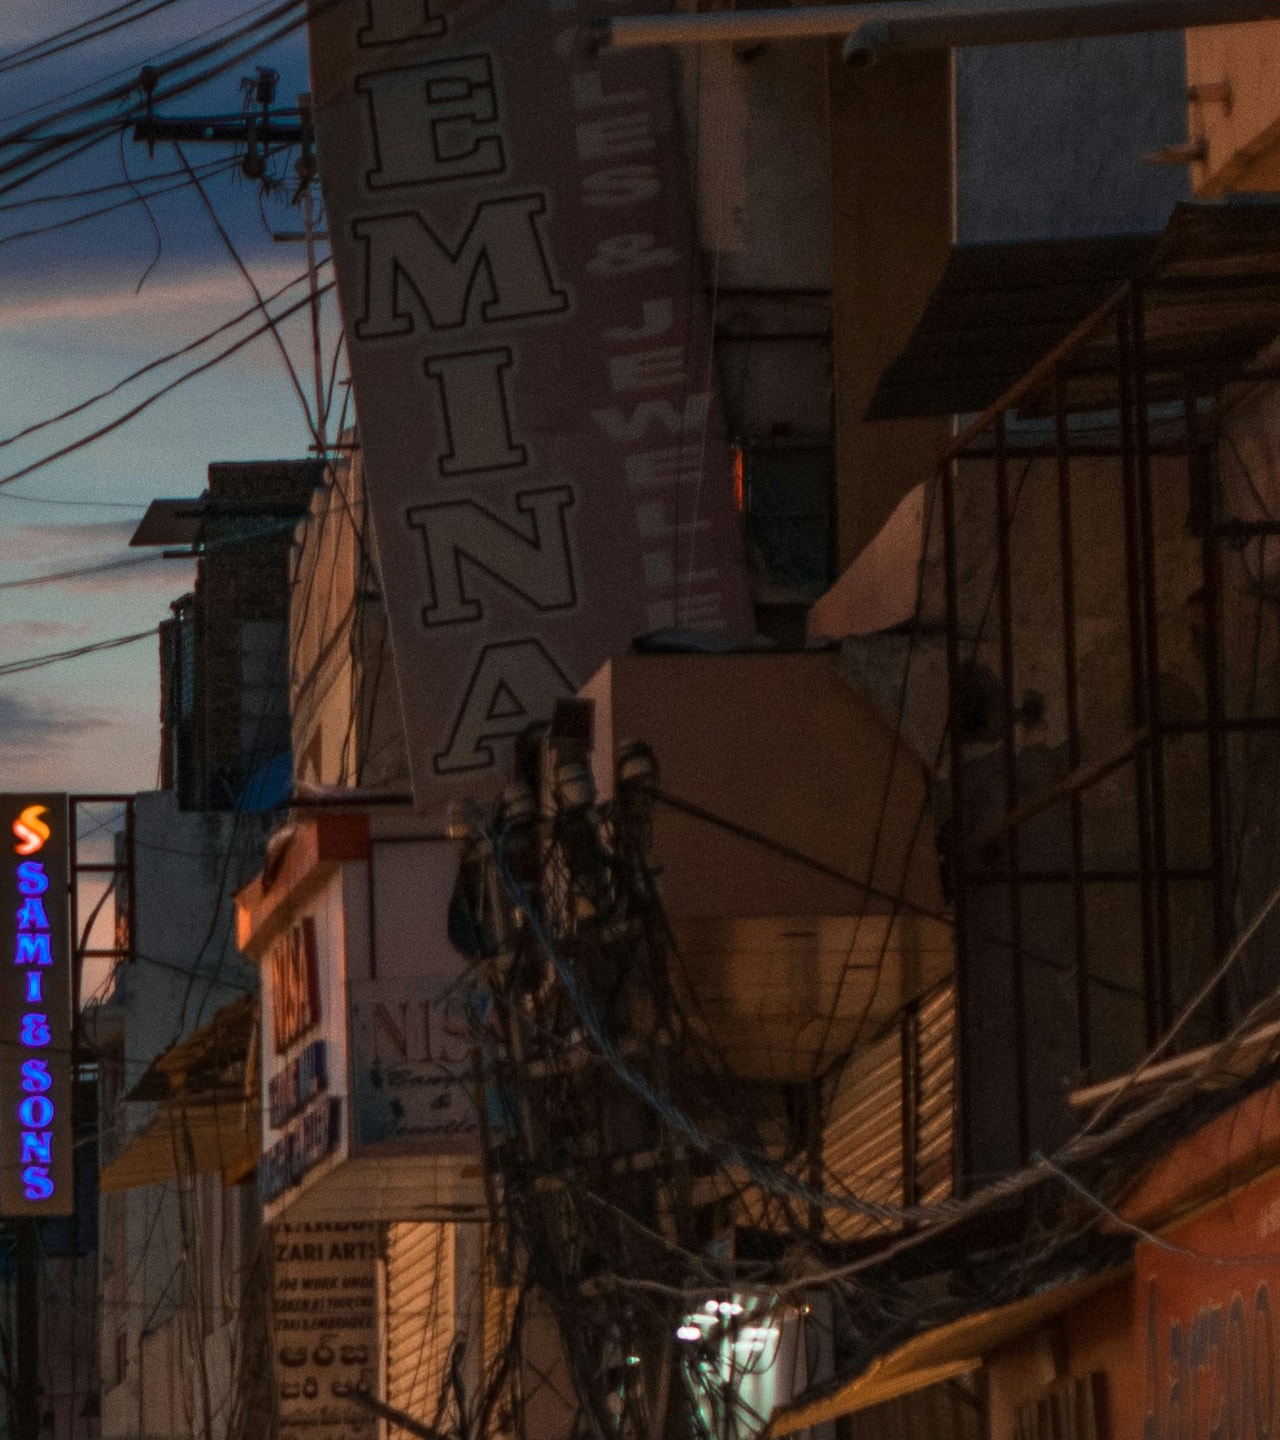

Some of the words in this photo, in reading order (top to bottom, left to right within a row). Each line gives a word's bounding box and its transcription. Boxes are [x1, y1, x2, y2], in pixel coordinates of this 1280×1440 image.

[14, 860, 54, 1003] SAMI
[19, 1010, 53, 1048] &
[17, 1058, 56, 1201] SONS
